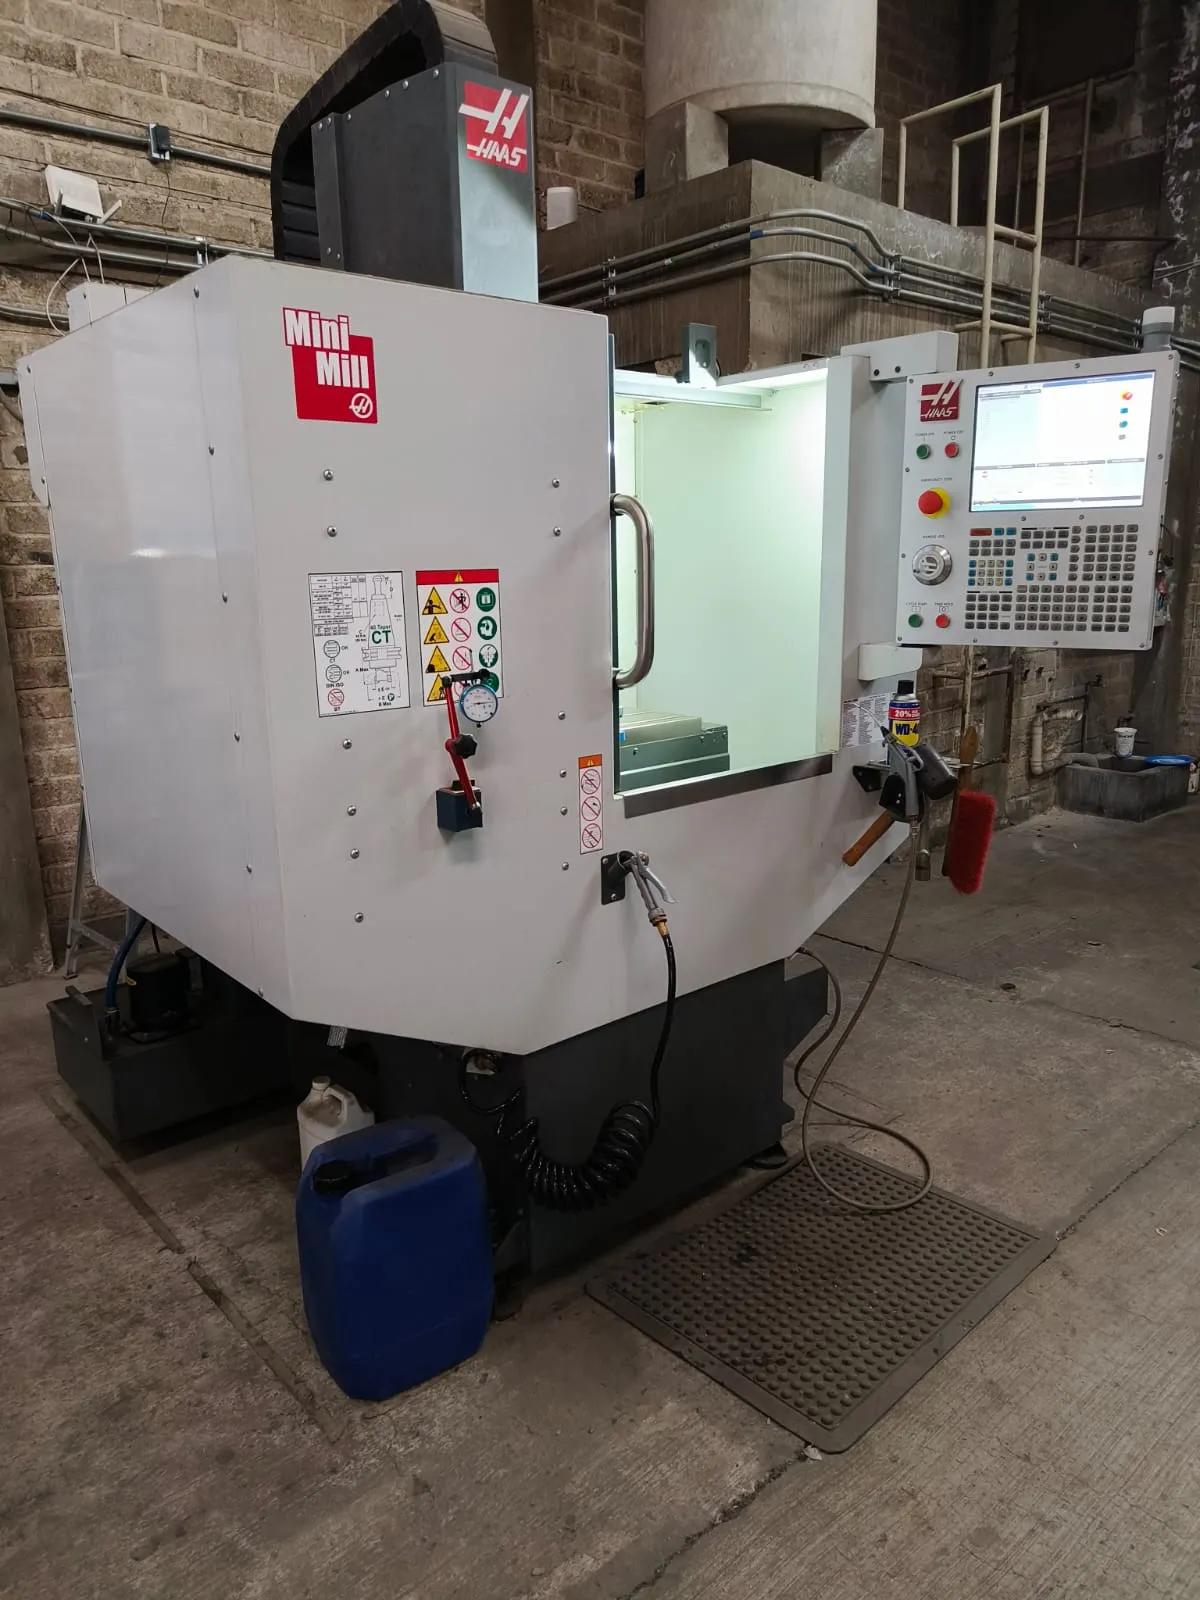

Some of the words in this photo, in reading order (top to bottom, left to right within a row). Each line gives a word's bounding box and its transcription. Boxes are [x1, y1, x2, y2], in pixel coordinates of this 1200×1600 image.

[467, 138, 527, 167] HAAS
[284, 308, 350, 351] Mini
[315, 350, 370, 389] Mill
[920, 407, 957, 418] HAAS
[371, 630, 392, 644] CT
[895, 709, 911, 718] 20%
